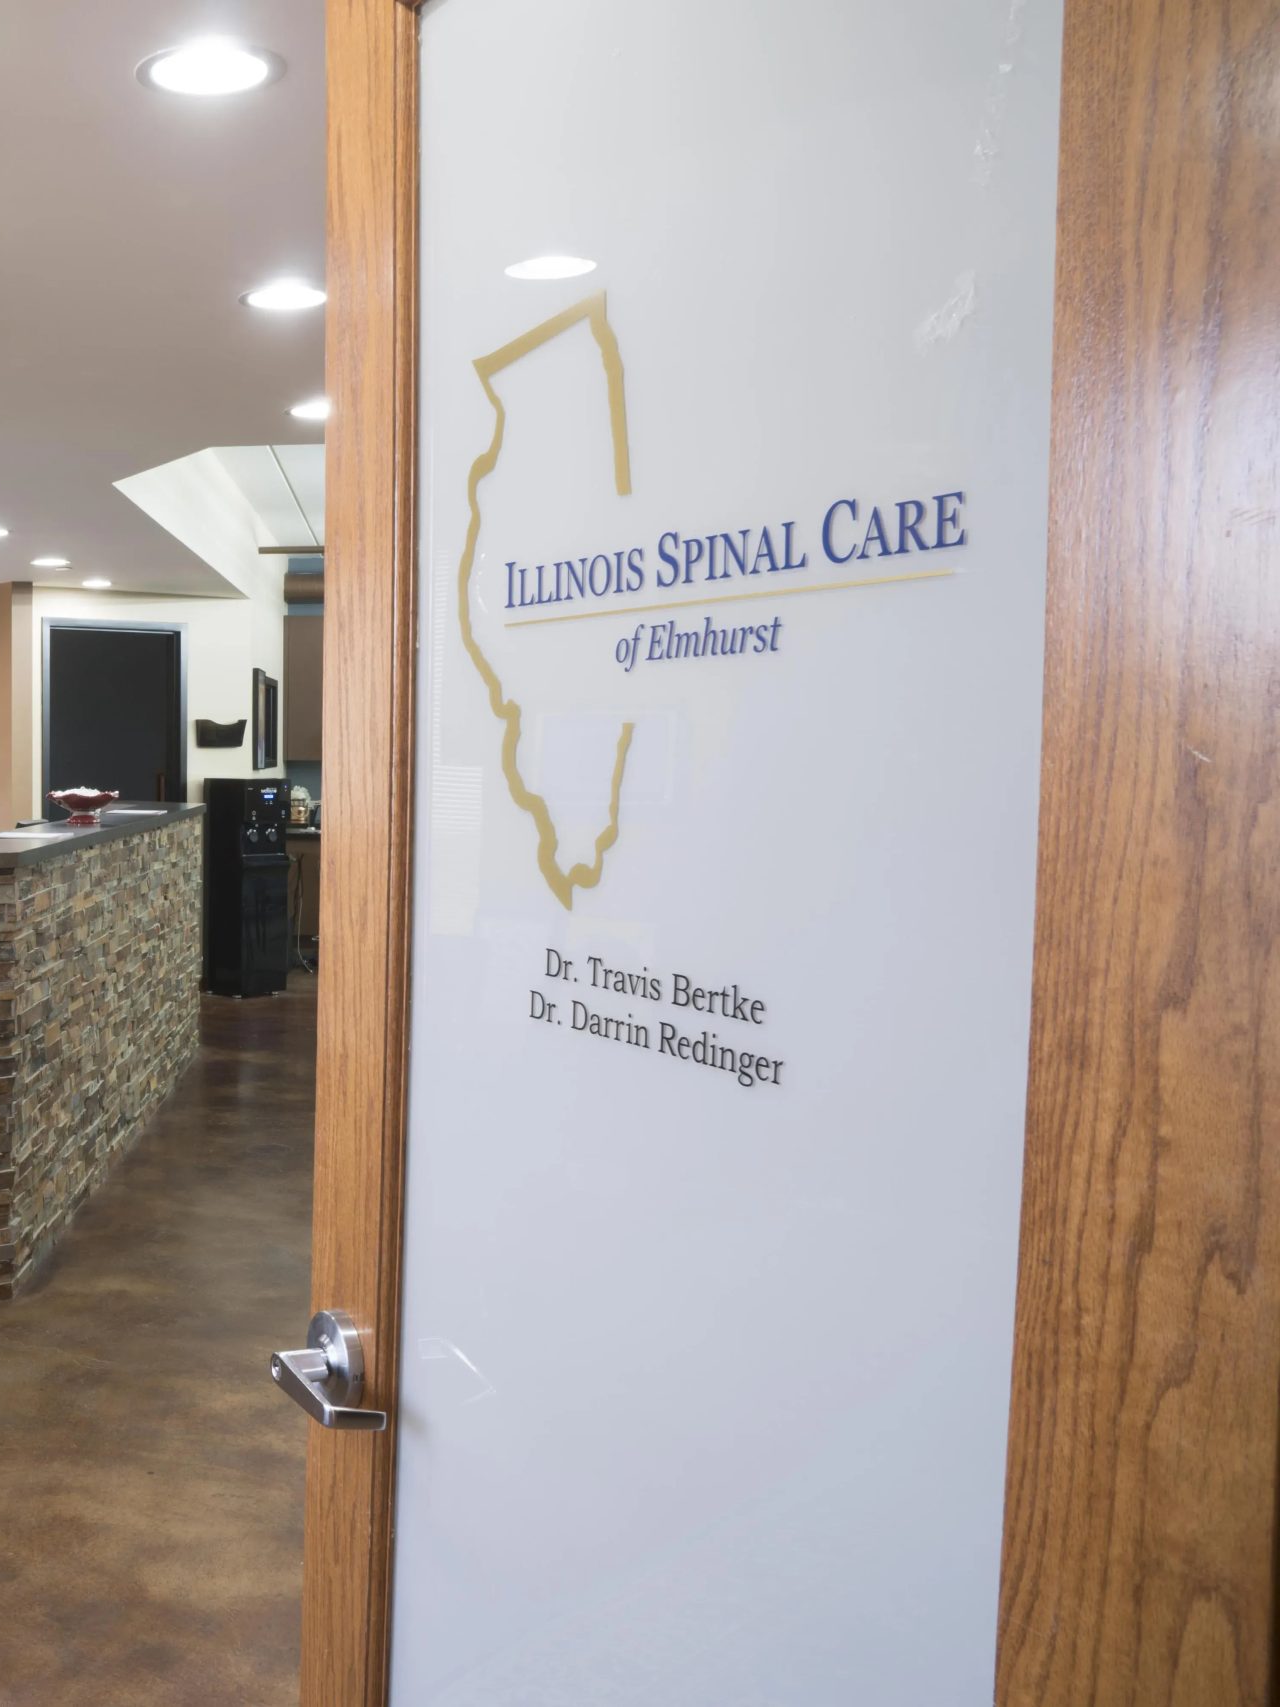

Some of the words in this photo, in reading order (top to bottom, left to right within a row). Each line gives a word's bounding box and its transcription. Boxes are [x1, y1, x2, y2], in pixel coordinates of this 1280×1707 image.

[504, 547, 645, 610] ILLINOIS
[655, 521, 807, 589] SPINAL
[821, 491, 968, 564] CARE
[615, 622, 646, 673] of
[645, 616, 783, 662] Elmhurst
[545, 948, 579, 984] Dr.
[586, 956, 661, 1002] Travis
[671, 973, 766, 1026] Bertke
[529, 990, 563, 1027] Dr.
[571, 1001, 650, 1050] Darrin
[658, 1023, 784, 1088] Redinger
